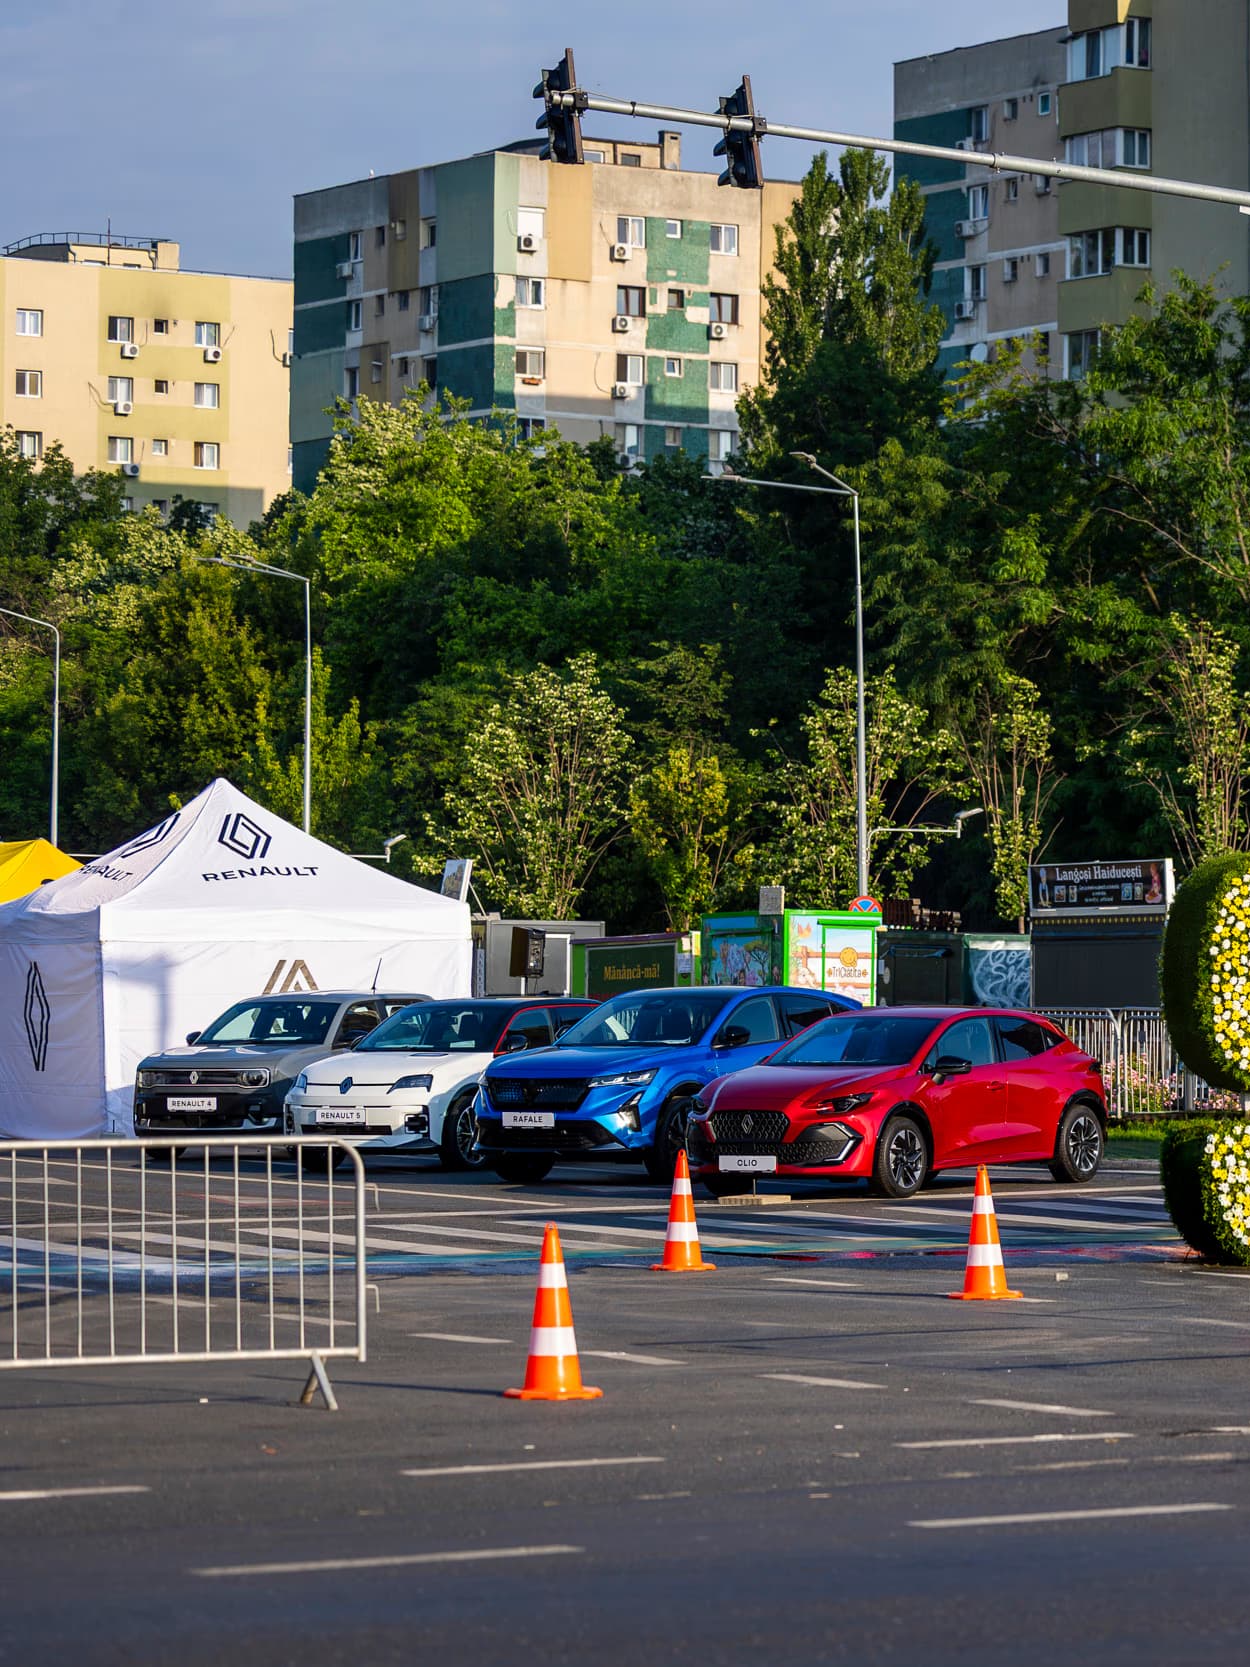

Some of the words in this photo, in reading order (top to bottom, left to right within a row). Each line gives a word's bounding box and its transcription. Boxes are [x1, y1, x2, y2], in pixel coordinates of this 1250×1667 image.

[202, 866, 320, 882] RENAULT
[1093, 865, 1142, 881] Haiducești
[512, 1115, 543, 1124] RAFALE
[736, 1159, 758, 1167] CLIO
